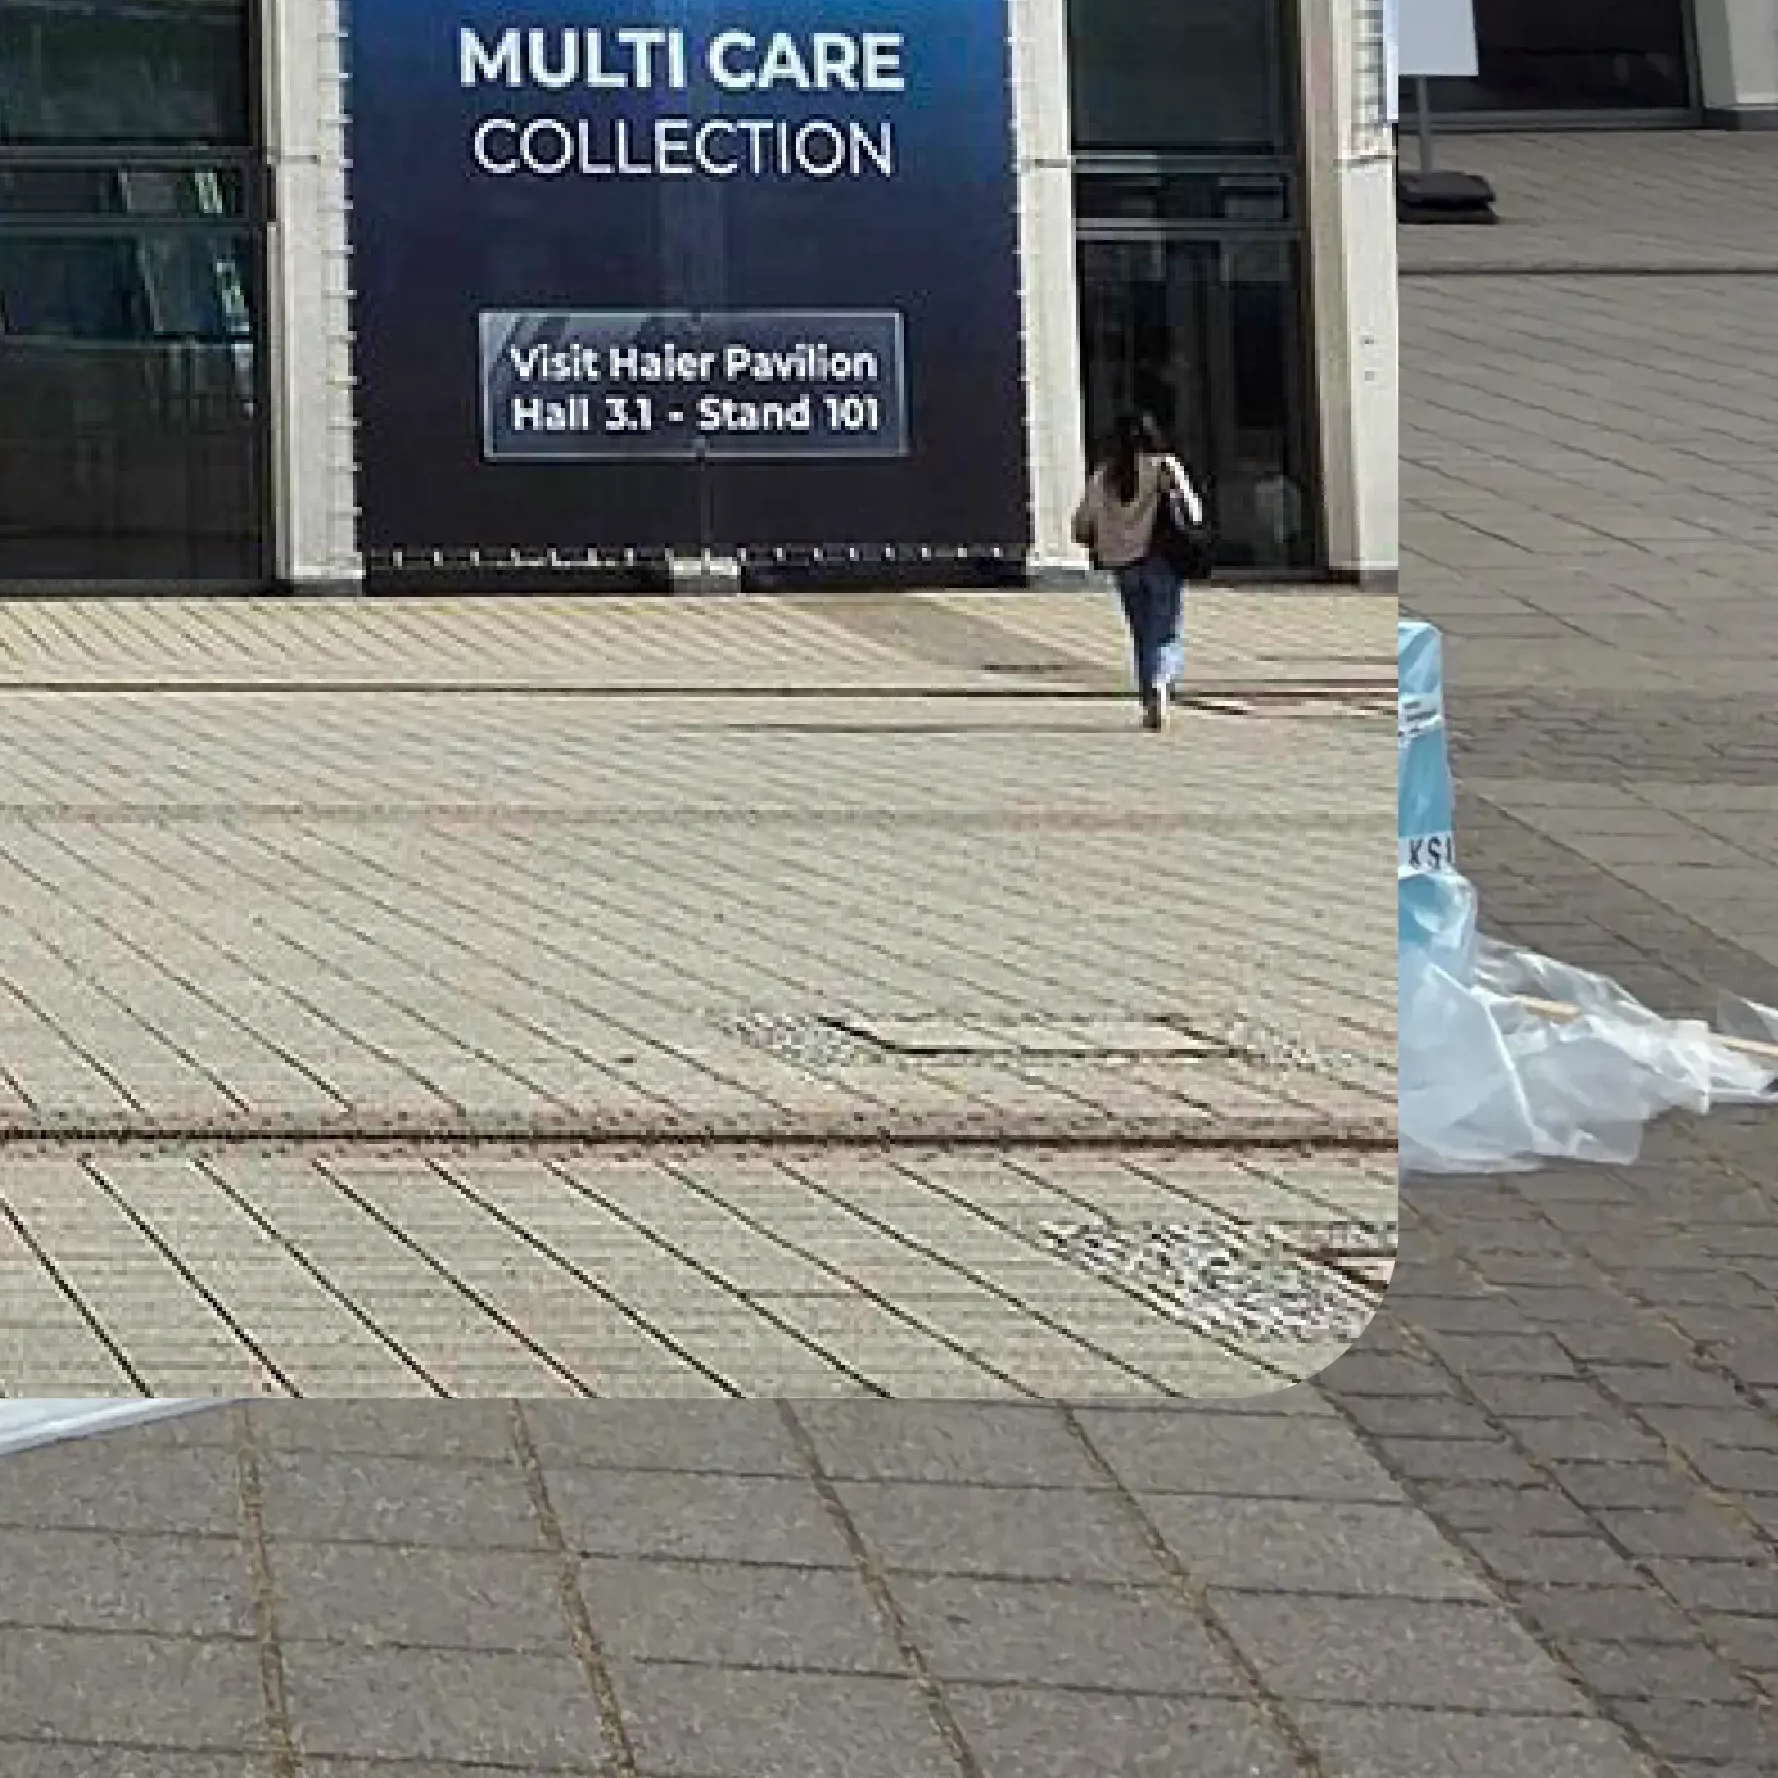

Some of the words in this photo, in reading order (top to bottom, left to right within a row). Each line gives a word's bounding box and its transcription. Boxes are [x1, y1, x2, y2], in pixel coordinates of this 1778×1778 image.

[459, 27, 686, 89] MULTI
[707, 32, 906, 93] CARE
[472, 118, 895, 178] COLLECTION
[510, 343, 598, 382] Visit
[609, 343, 716, 382] Haier
[725, 343, 878, 382] Pavilion
[514, 393, 589, 431] Hall
[605, 396, 652, 431] 3.1
[696, 393, 810, 431] Stand
[824, 396, 878, 431] 101
